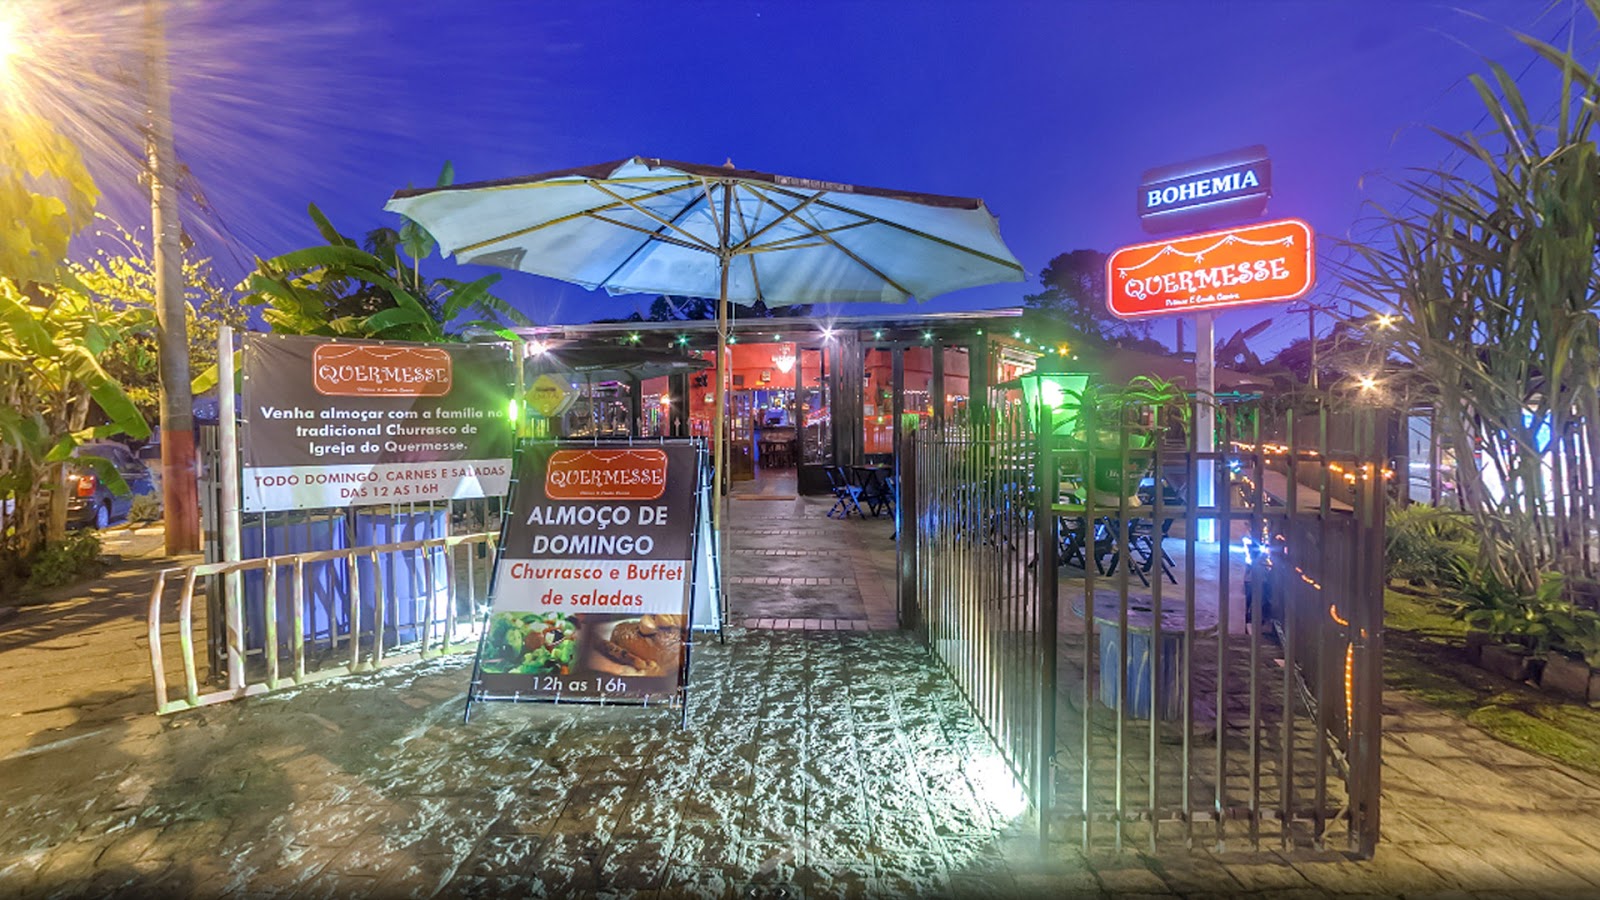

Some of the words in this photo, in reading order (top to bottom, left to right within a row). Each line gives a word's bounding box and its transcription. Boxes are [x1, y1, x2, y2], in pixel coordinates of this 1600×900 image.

[1147, 170, 1259, 208] BOHEMIA
[1124, 257, 1290, 300] QUERMESSE
[318, 364, 449, 385] QUERMESSE
[260, 406, 315, 419] Venha
[320, 406, 384, 421] almoçar
[388, 409, 418, 419] com
[422, 409, 432, 419] a
[435, 406, 483, 419] família
[487, 409, 503, 418] no
[296, 424, 381, 437] tradicional
[385, 423, 456, 436] Churrasco
[461, 424, 477, 435] de
[309, 442, 355, 457] Igreja
[360, 441, 380, 453] do
[384, 440, 468, 453] Quermesse.
[254, 474, 300, 488] TODO
[386, 468, 437, 481] CARNES
[441, 468, 448, 479] E
[451, 465, 505, 478] SALADAS
[550, 468, 664, 488] QUERMESSE
[340, 485, 368, 498] DAS
[373, 485, 389, 497] 12
[393, 484, 411, 496] AS
[415, 483, 439, 495] 16H
[527, 505, 630, 530] ALMOÇO
[637, 505, 668, 525] DE
[532, 534, 654, 555] DOMINGO
[510, 563, 603, 580] Churrasco
[609, 567, 620, 580] e
[626, 563, 683, 581] Buffet
[540, 589, 563, 606] de
[570, 588, 643, 606] saladas
[532, 676, 563, 691] 12h
[568, 679, 588, 692] as
[596, 676, 626, 692] 16h
